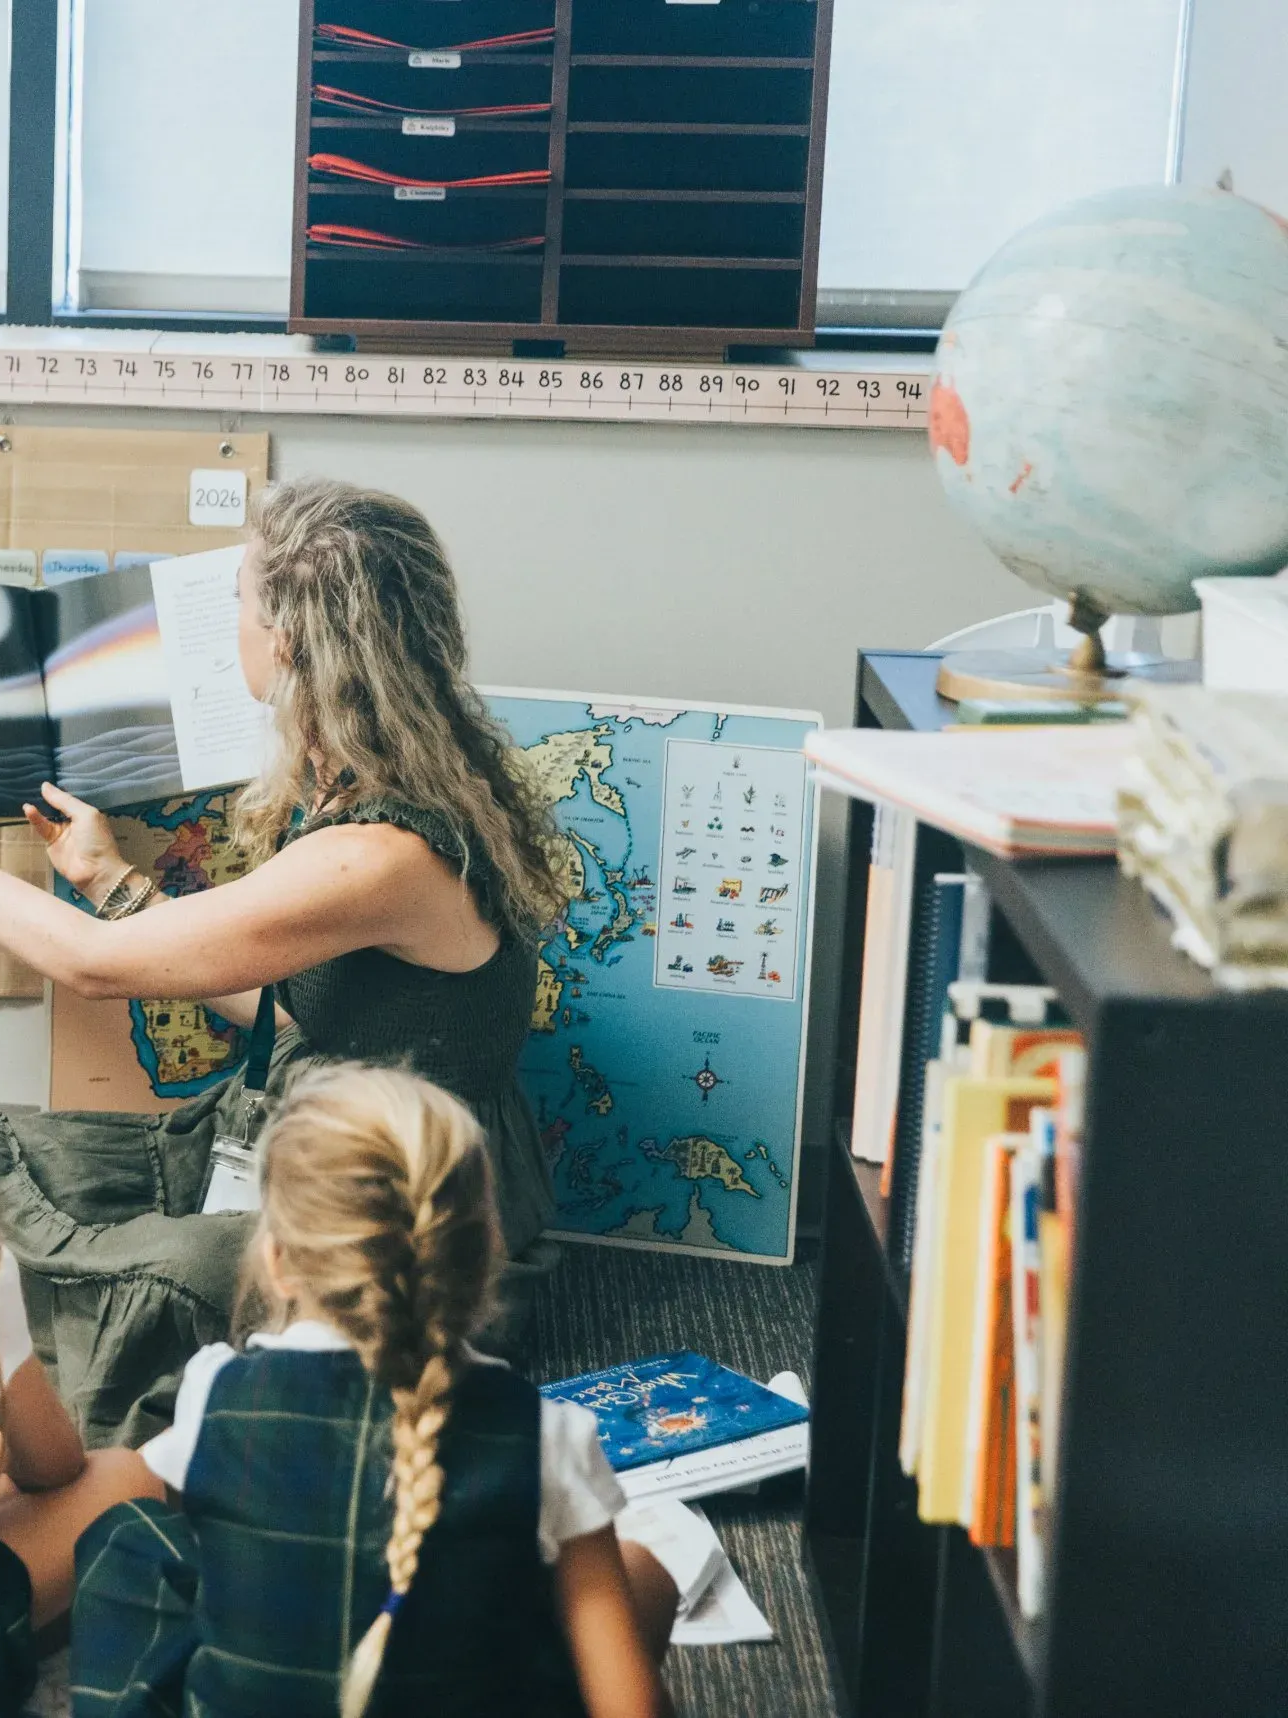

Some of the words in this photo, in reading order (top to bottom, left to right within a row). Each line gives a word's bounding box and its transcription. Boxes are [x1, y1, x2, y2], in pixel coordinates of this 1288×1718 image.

[4, 355, 21, 373] 71
[36, 356, 59, 374] 72
[74, 357, 98, 376] 73
[113, 359, 138, 377] 74
[153, 360, 176, 378] 75
[191, 361, 214, 380] 76
[230, 362, 253, 380] 77
[266, 364, 290, 382] 78
[305, 364, 329, 383] 79
[344, 365, 370, 383] 80
[387, 366, 405, 384] 81
[422, 367, 448, 385] 82
[462, 367, 488, 387] 83
[498, 368, 525, 388] 84
[538, 369, 563, 389] 85
[579, 371, 604, 389] 86
[619, 372, 644, 391] 87
[658, 373, 683, 392] 88
[698, 375, 723, 393] 89
[734, 376, 760, 394] 90
[777, 377, 796, 396] 91
[816, 378, 841, 397] 92
[856, 379, 881, 399] 93
[895, 380, 923, 400] 94
[195, 487, 241, 508] 2026
[51, 560, 100, 574] Thursday
[571, 1372, 641, 1400] Made
[629, 1372, 699, 1392] When
[583, 1391, 639, 1412] God
